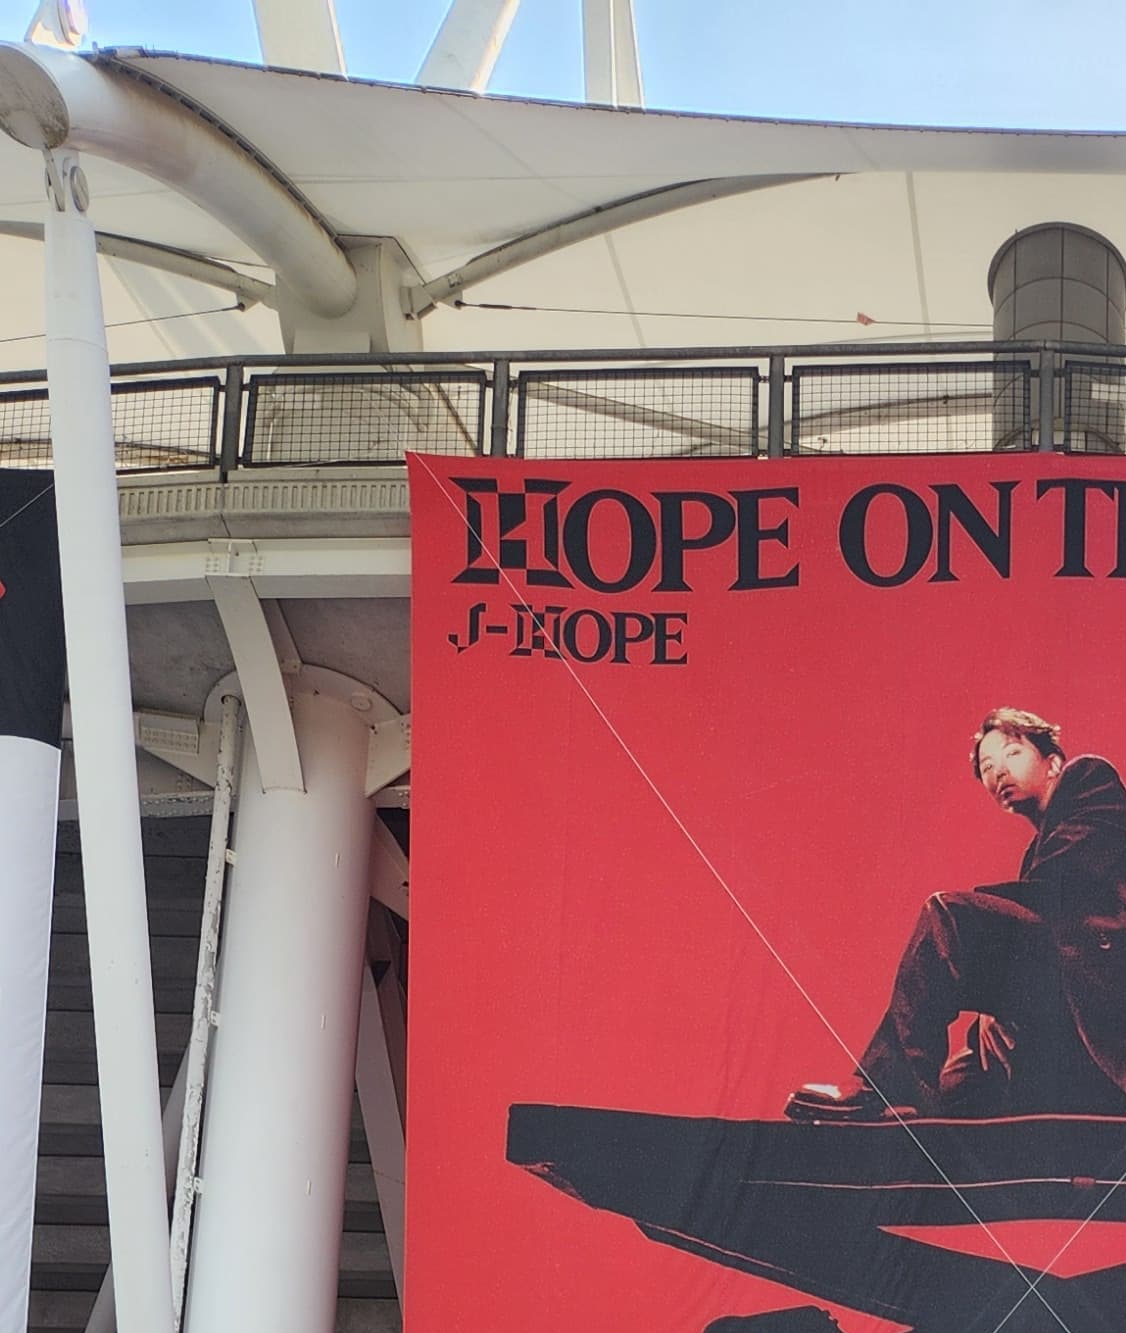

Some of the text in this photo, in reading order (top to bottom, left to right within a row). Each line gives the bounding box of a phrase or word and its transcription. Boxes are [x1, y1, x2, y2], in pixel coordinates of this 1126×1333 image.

[449, 477, 799, 592] HOPE
[839, 480, 1022, 588] ON
[448, 602, 688, 664] J-HOPE
